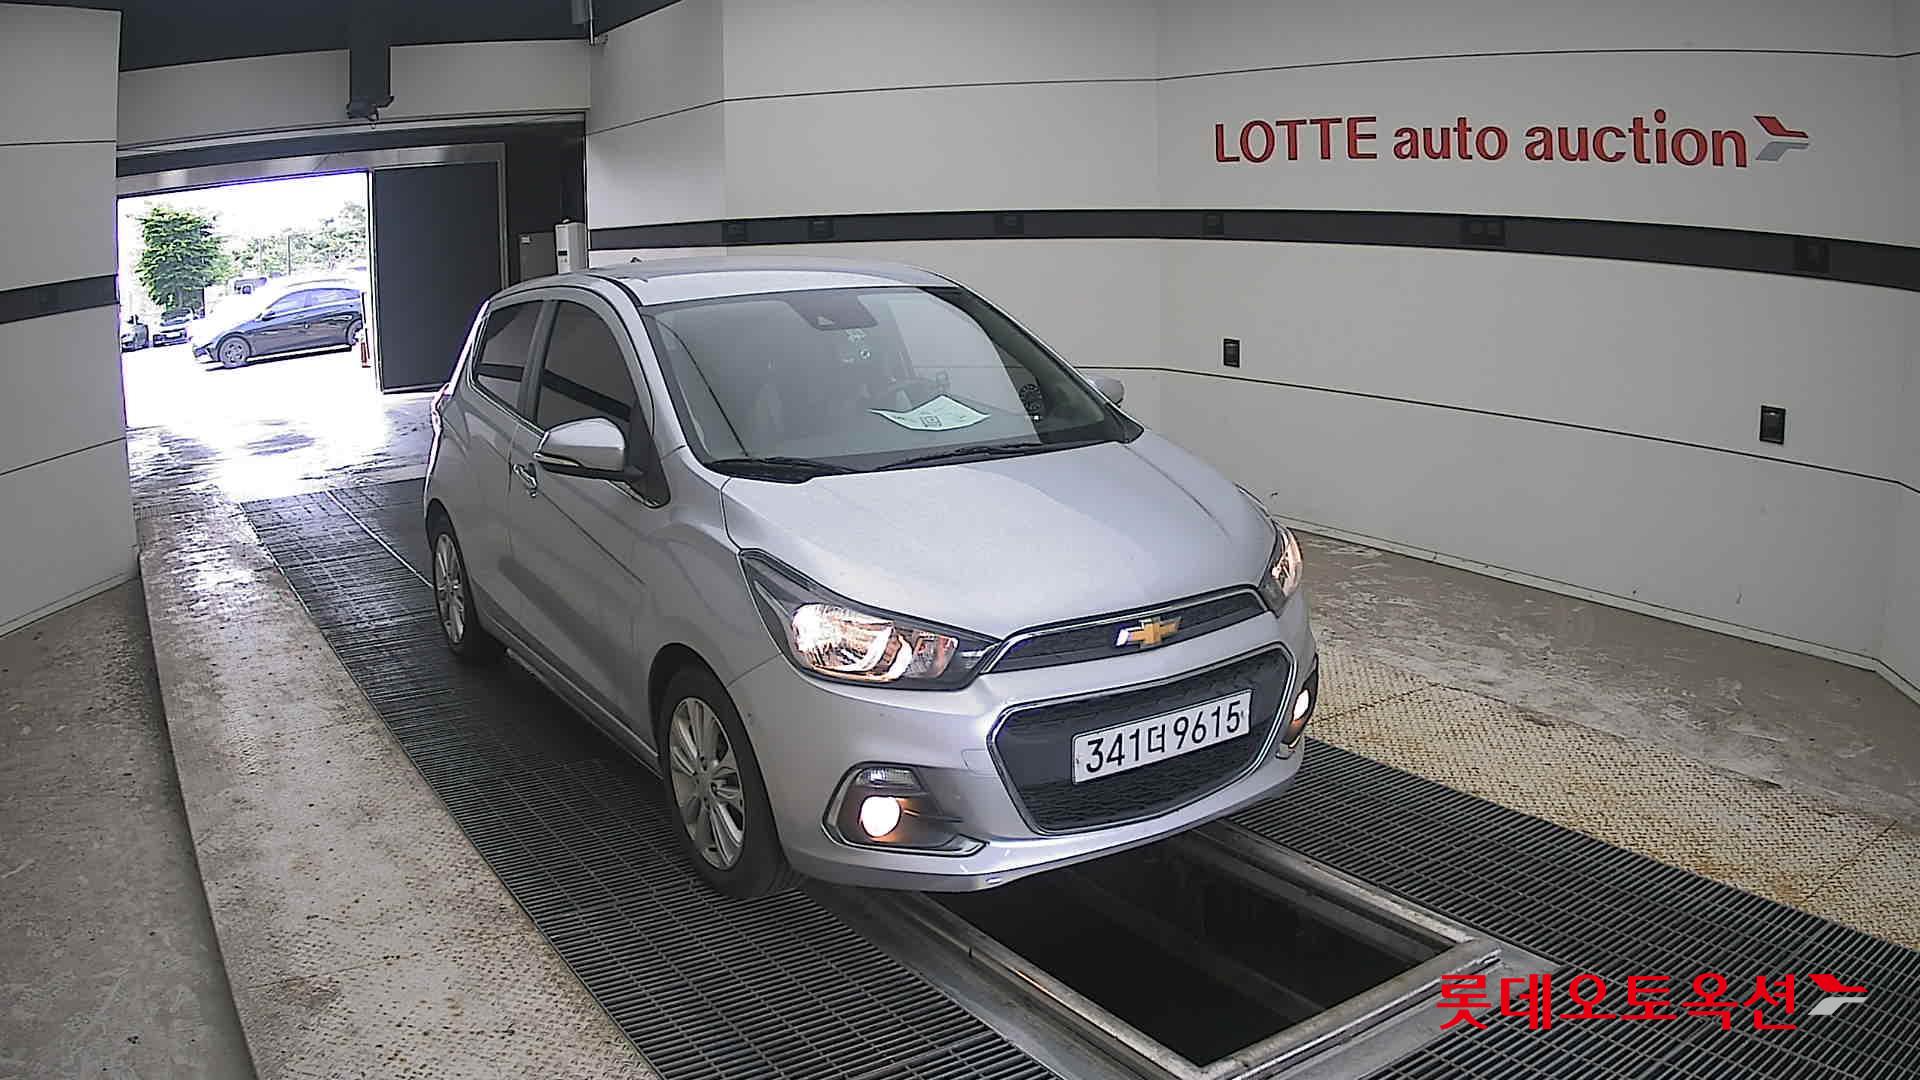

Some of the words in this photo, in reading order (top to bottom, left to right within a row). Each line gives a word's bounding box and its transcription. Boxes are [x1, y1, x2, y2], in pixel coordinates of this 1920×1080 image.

[1215, 116, 1377, 163] LOTTE
[1392, 116, 1509, 162] auto
[1524, 108, 1748, 168] auction
